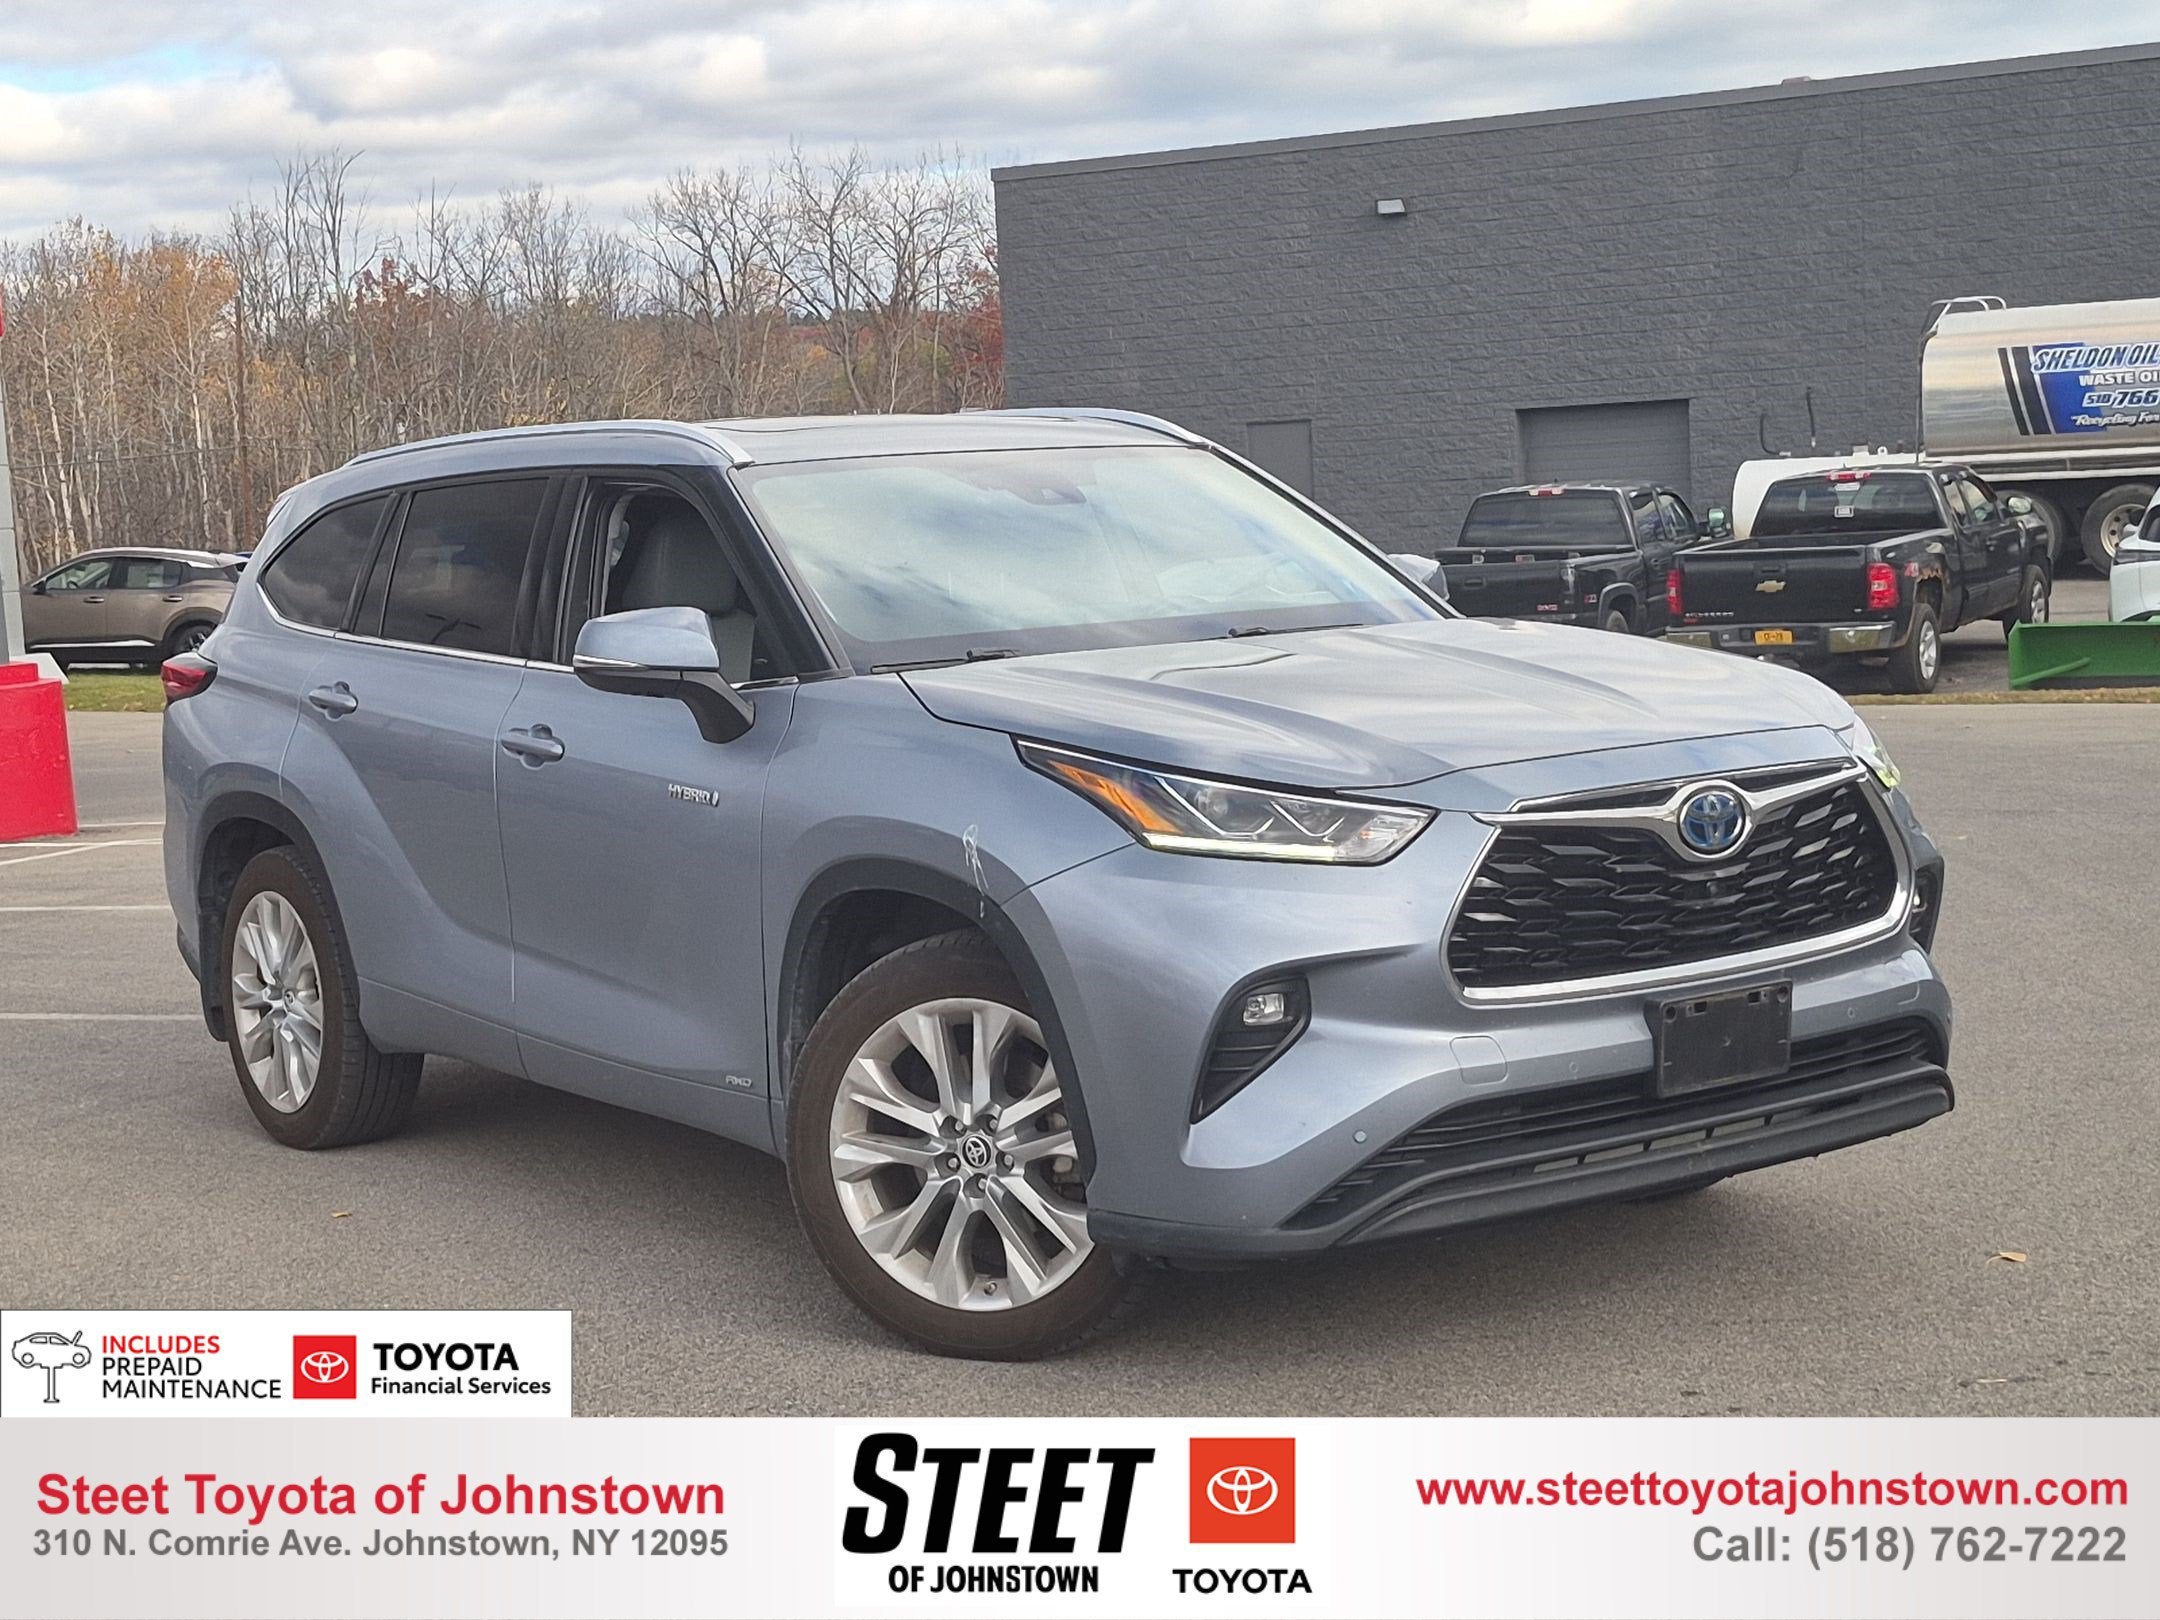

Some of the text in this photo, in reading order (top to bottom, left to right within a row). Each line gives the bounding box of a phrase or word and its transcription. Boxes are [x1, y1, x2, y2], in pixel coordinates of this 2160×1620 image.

[2032, 345, 2130, 372] SHELDON
[2079, 370, 2160, 386] WASTE OI
[668, 784, 711, 805] HYBRID
